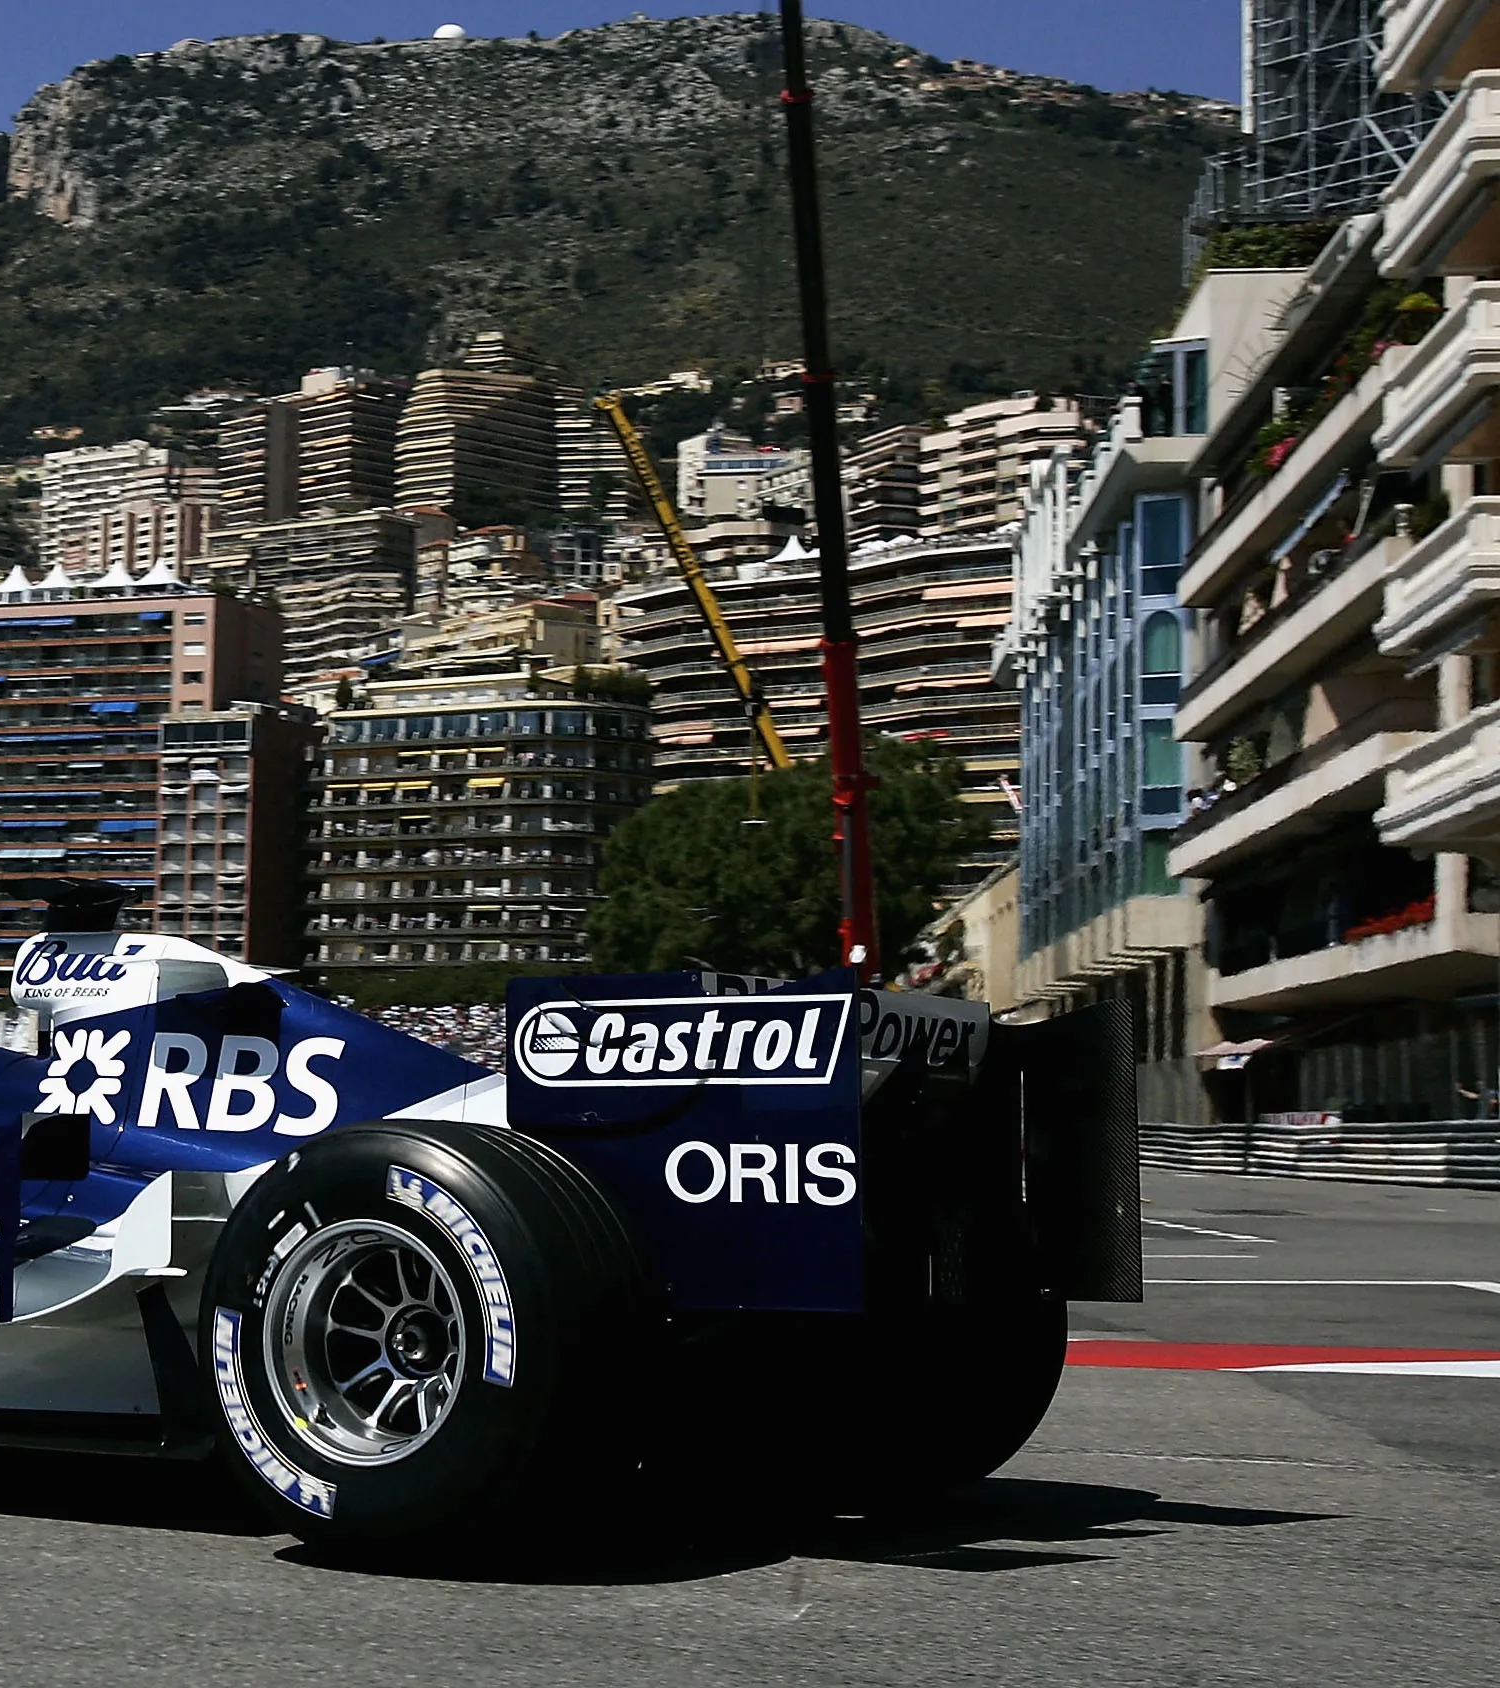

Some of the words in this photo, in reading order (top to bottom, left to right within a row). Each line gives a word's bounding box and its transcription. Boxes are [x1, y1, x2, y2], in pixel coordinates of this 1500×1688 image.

[23, 988, 51, 999] KING
[54, 987, 70, 998] OF
[71, 986, 110, 997] BEERS
[585, 1007, 821, 1074] Castrol
[137, 1033, 346, 1137] RBS
[665, 1141, 857, 1206] ORIS
[283, 1273, 310, 1346] RACING
[425, 1191, 513, 1380] MICHELIN
[216, 1312, 297, 1492] MICHELIN
